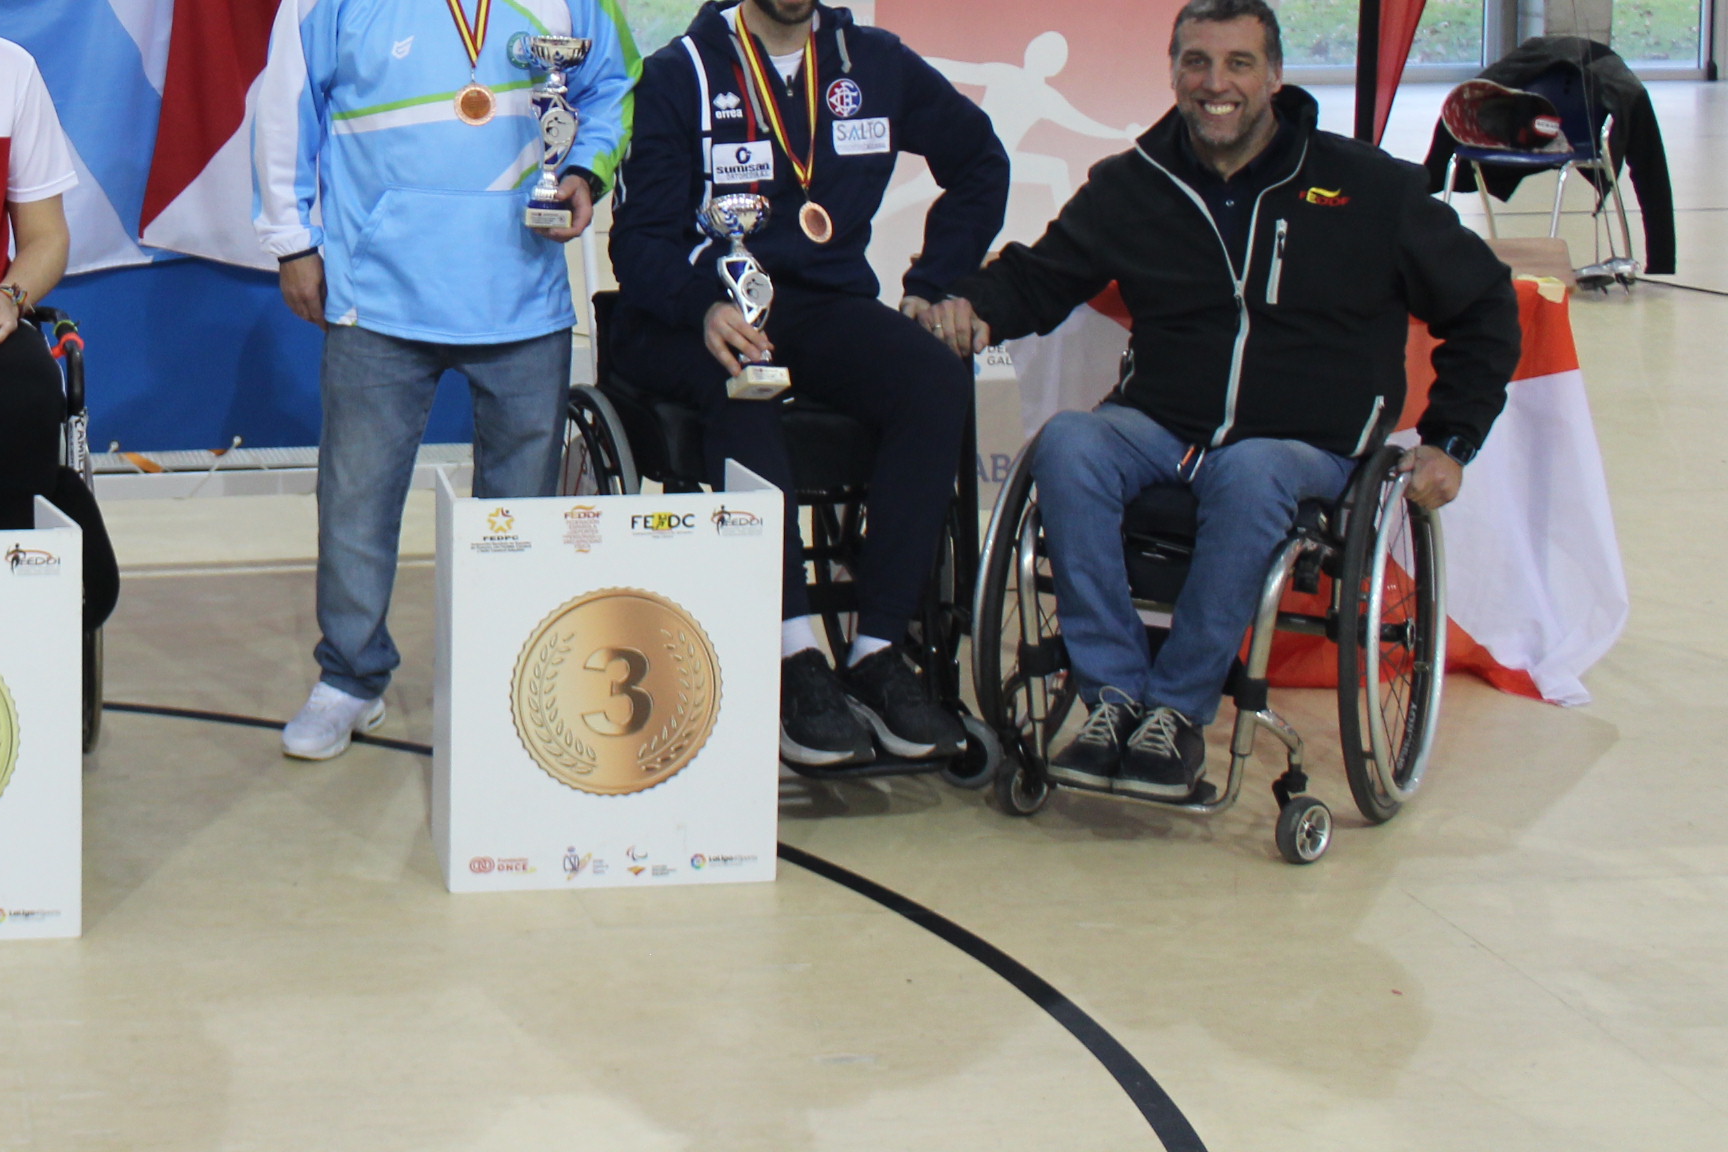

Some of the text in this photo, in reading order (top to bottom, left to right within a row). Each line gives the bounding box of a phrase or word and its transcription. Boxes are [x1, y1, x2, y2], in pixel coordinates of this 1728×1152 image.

[716, 109, 743, 119] errea
[836, 121, 886, 141] SALTO
[987, 356, 1013, 365] GAL
[581, 646, 653, 737] 3
[497, 863, 528, 872] ONCE
